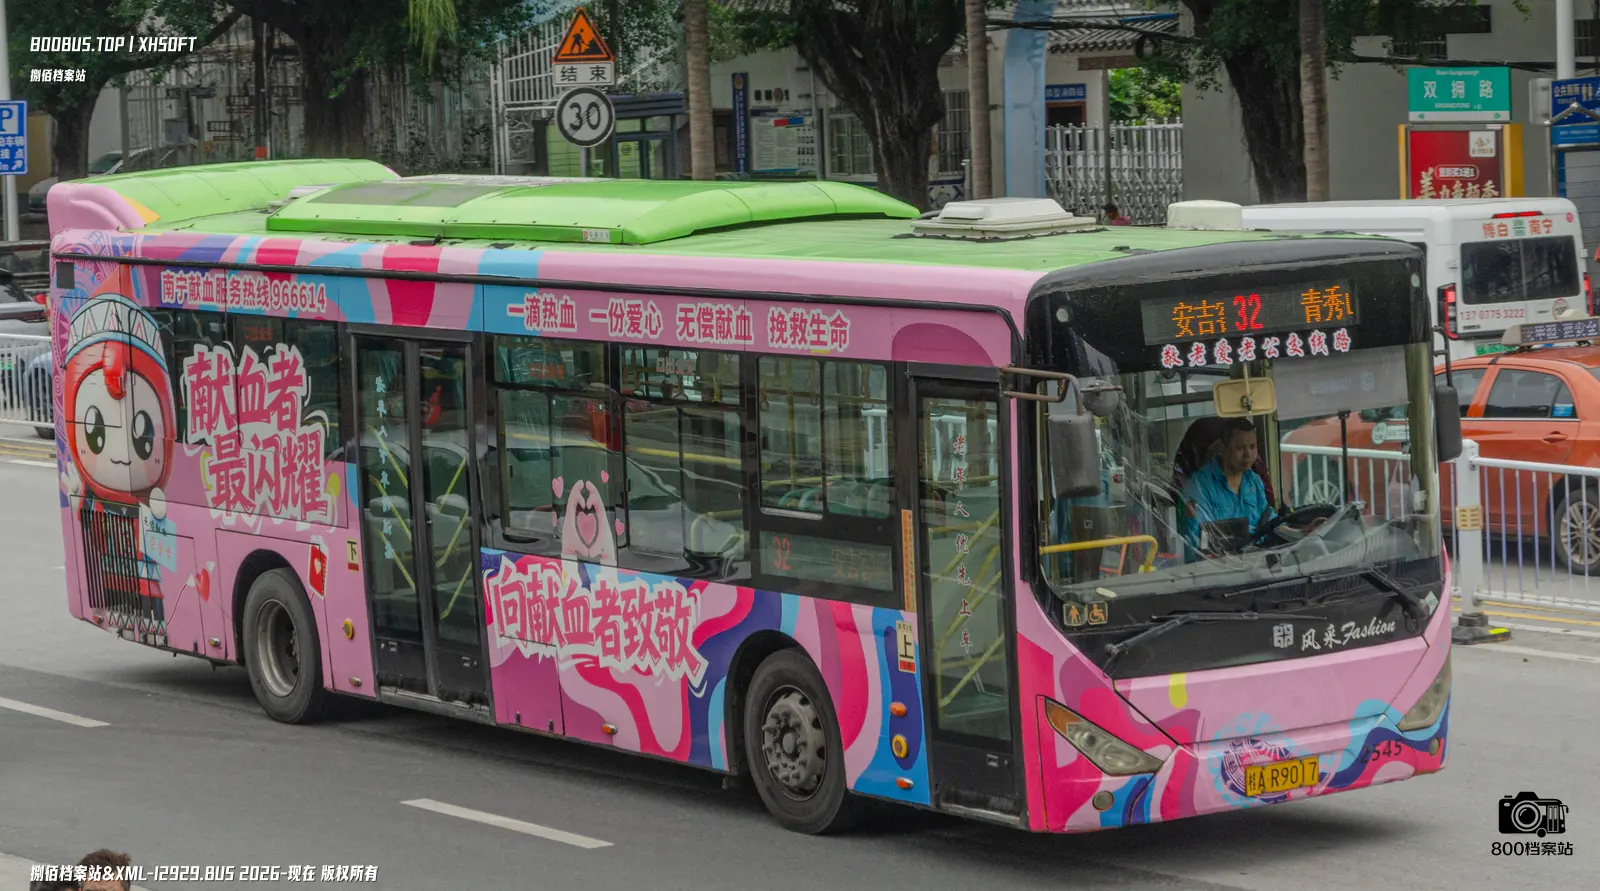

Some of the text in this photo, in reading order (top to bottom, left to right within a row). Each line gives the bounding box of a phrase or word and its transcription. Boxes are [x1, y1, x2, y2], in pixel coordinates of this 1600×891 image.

[560, 65, 607, 82] 结束
[1423, 79, 1494, 99] 双拥路
[569, 101, 600, 130] 30
[160, 270, 326, 312] 南宁献血服务热线966614
[507, 296, 850, 350] 一滴热血 一份爱心 无偿献血 挽救生命
[1232, 293, 1264, 332] 32
[1160, 328, 1352, 369] 敬老爱老公交线路
[185, 346, 307, 438] 献血者
[207, 429, 330, 522] 最闪耀
[346, 540, 357, 561] 下
[773, 535, 791, 571] 32
[491, 562, 706, 682] 向献血者致敬
[1301, 623, 1341, 652] 风采
[1340, 616, 1396, 646] Fashion
[899, 634, 914, 660] 上
[1360, 738, 1403, 764] 2545
